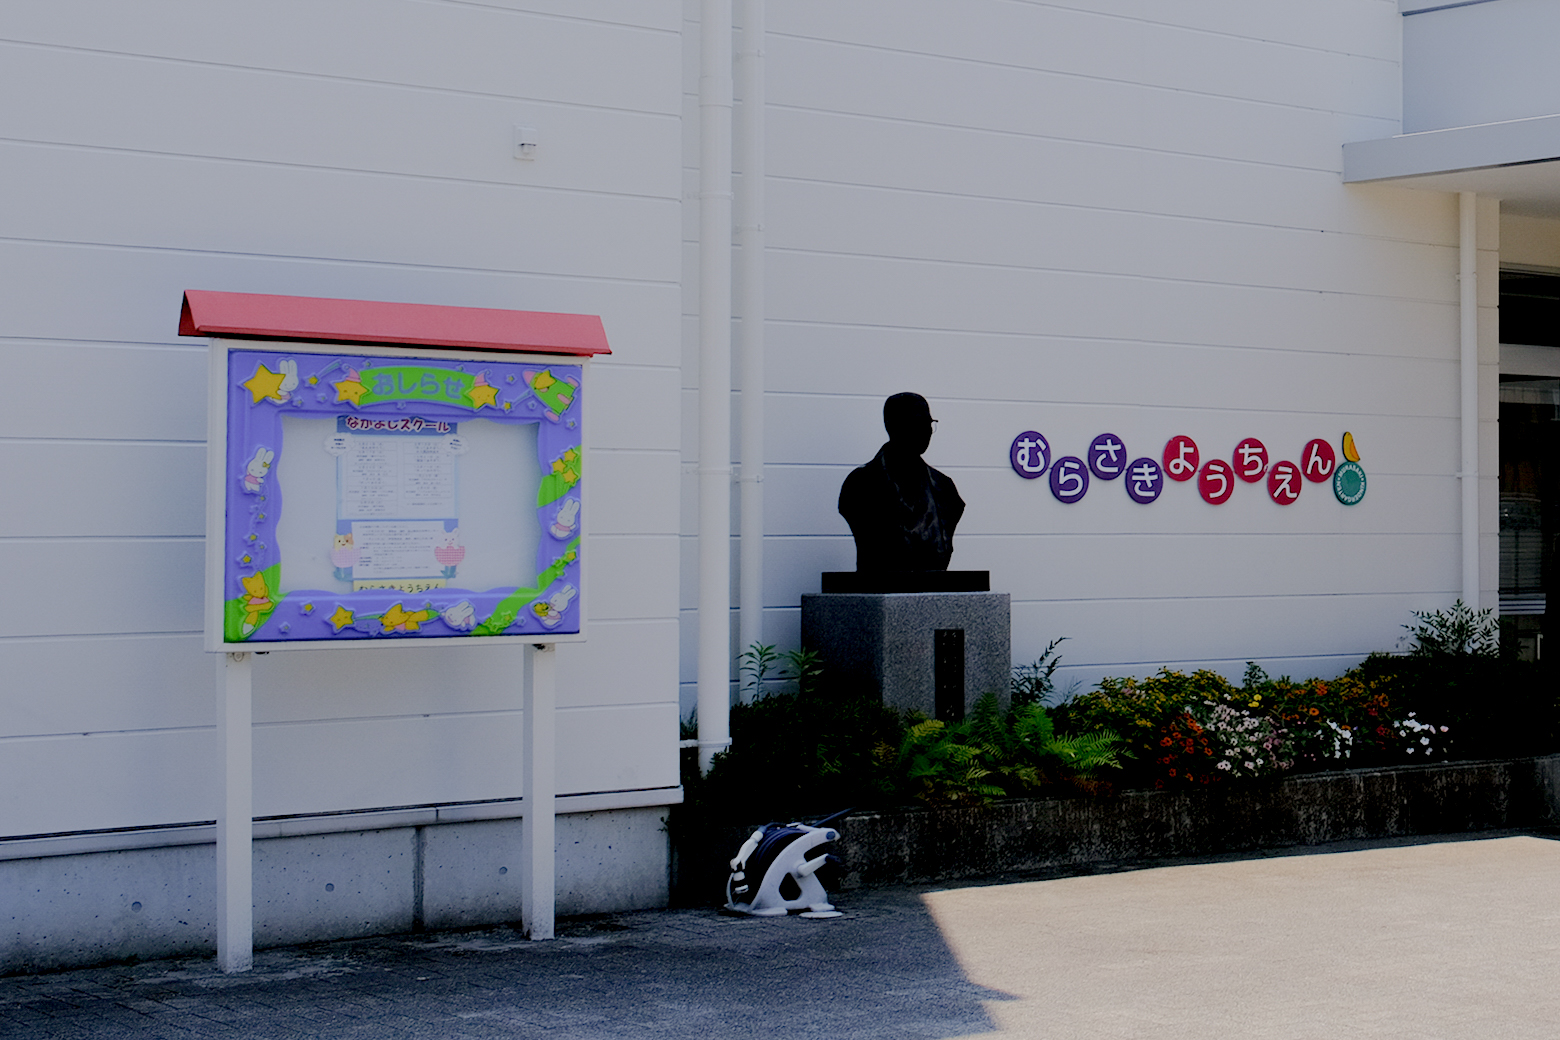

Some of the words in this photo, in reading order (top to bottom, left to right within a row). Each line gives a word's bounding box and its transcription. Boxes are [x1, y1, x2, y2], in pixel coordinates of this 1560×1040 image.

[372, 372, 466, 400] おしらせ
[1015, 436, 1332, 500] むらさきようちえん
[1338, 464, 1364, 478] MURASAKI
